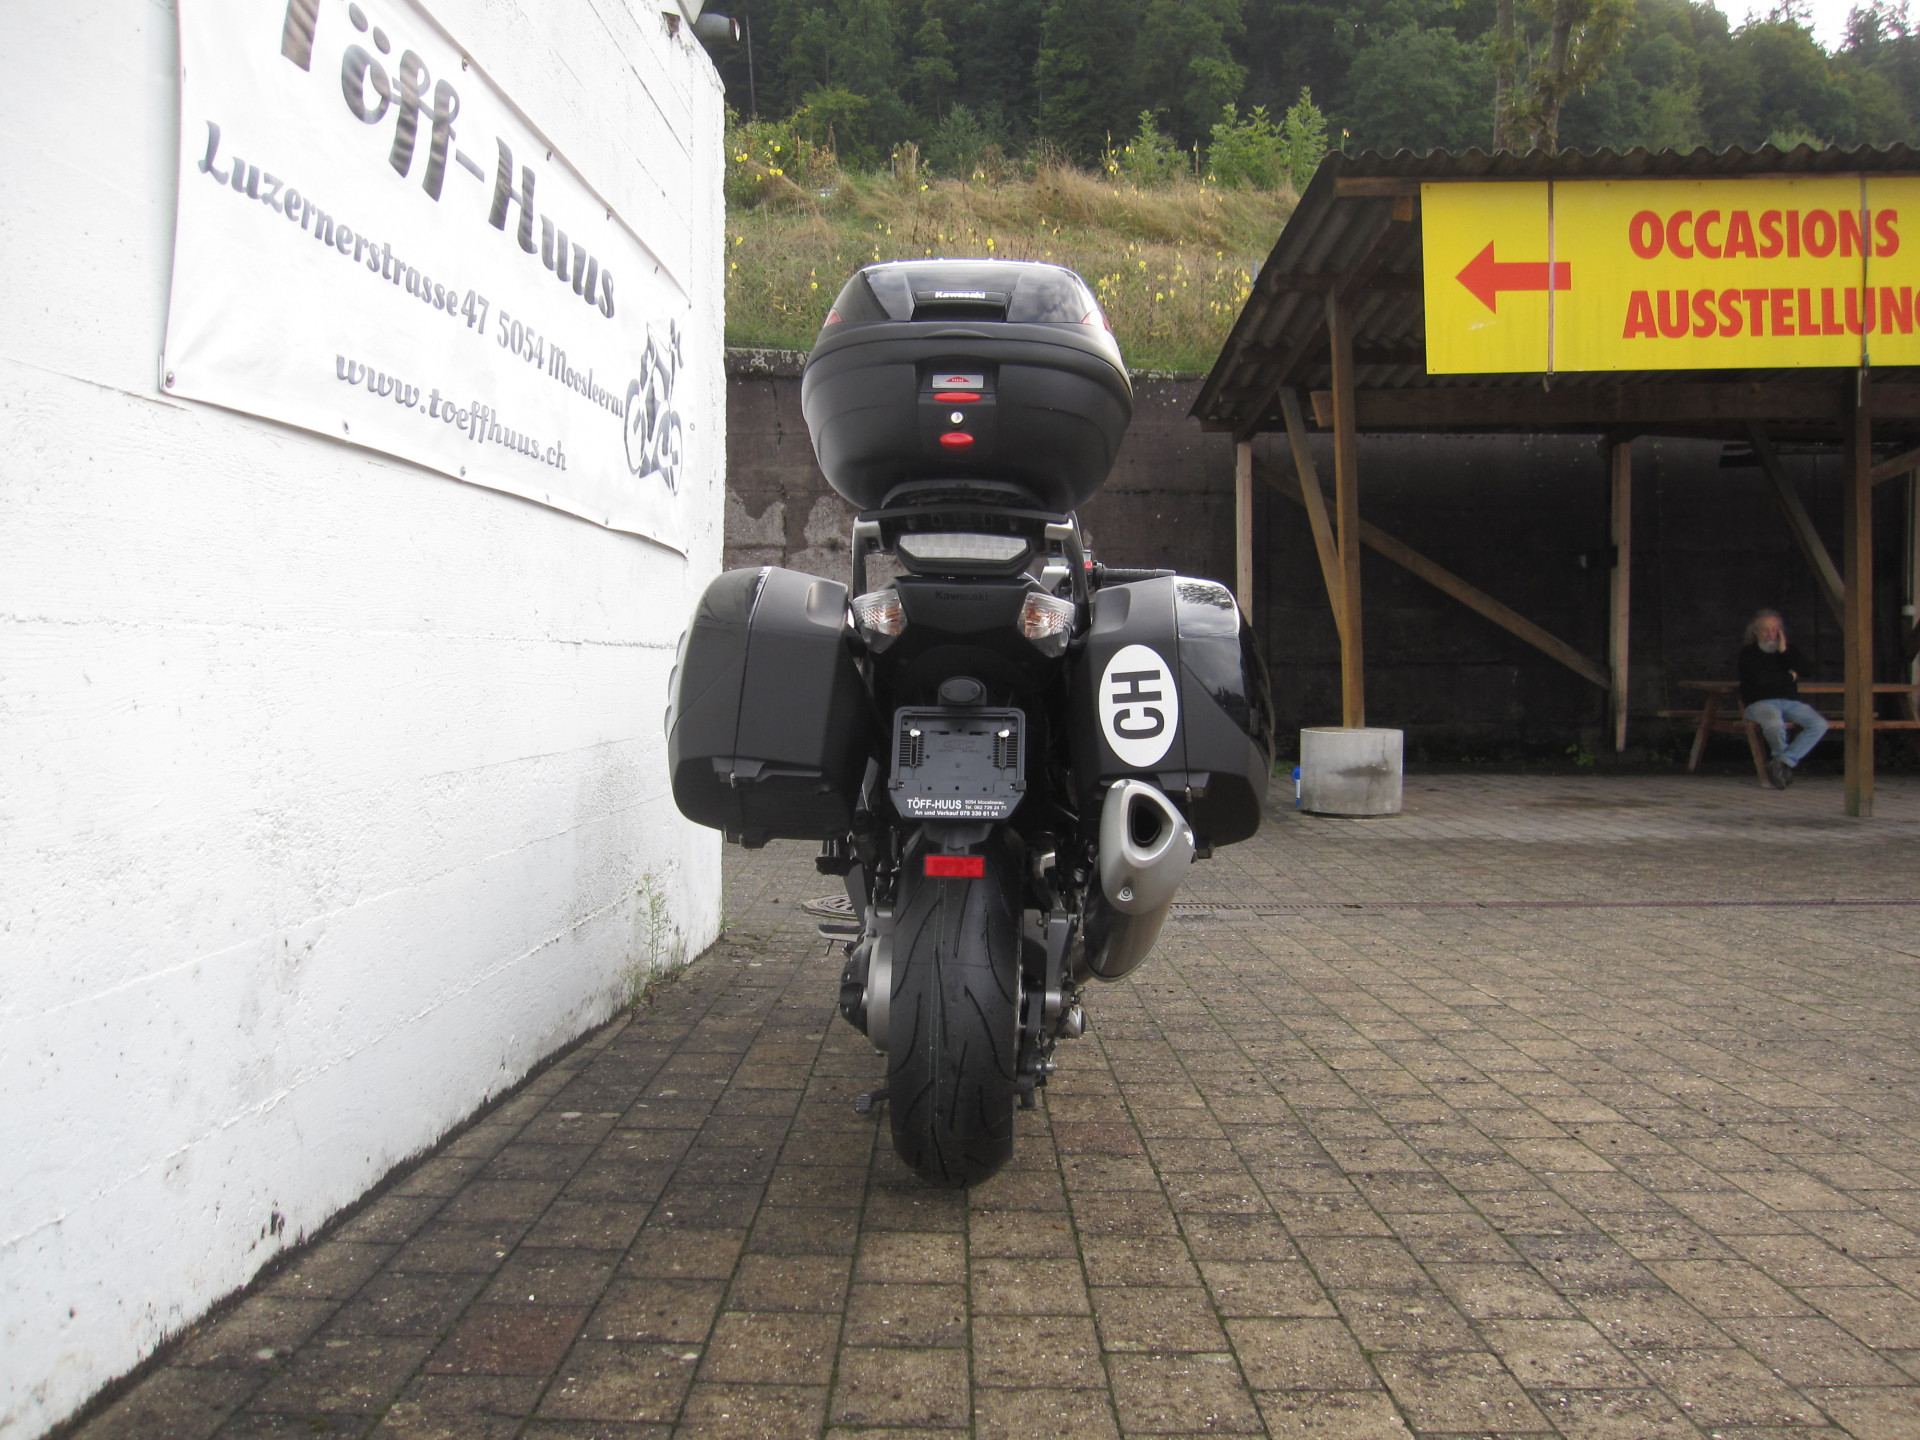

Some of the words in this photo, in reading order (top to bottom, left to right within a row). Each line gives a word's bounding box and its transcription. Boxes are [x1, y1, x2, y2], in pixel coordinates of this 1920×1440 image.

[197, 120, 458, 317] Luzernerstrasse
[460, 289, 490, 334] 47
[497, 309, 544, 370] 5054
[1629, 209, 1900, 260] OCCASIONS
[935, 291, 986, 299] Kawasaki
[1623, 286, 1920, 339] AUSSTELLUN
[336, 354, 567, 471] www.toeffhuus.ch
[1111, 669, 1165, 740] CH
[907, 797, 962, 809] TÖFF-HUUS
